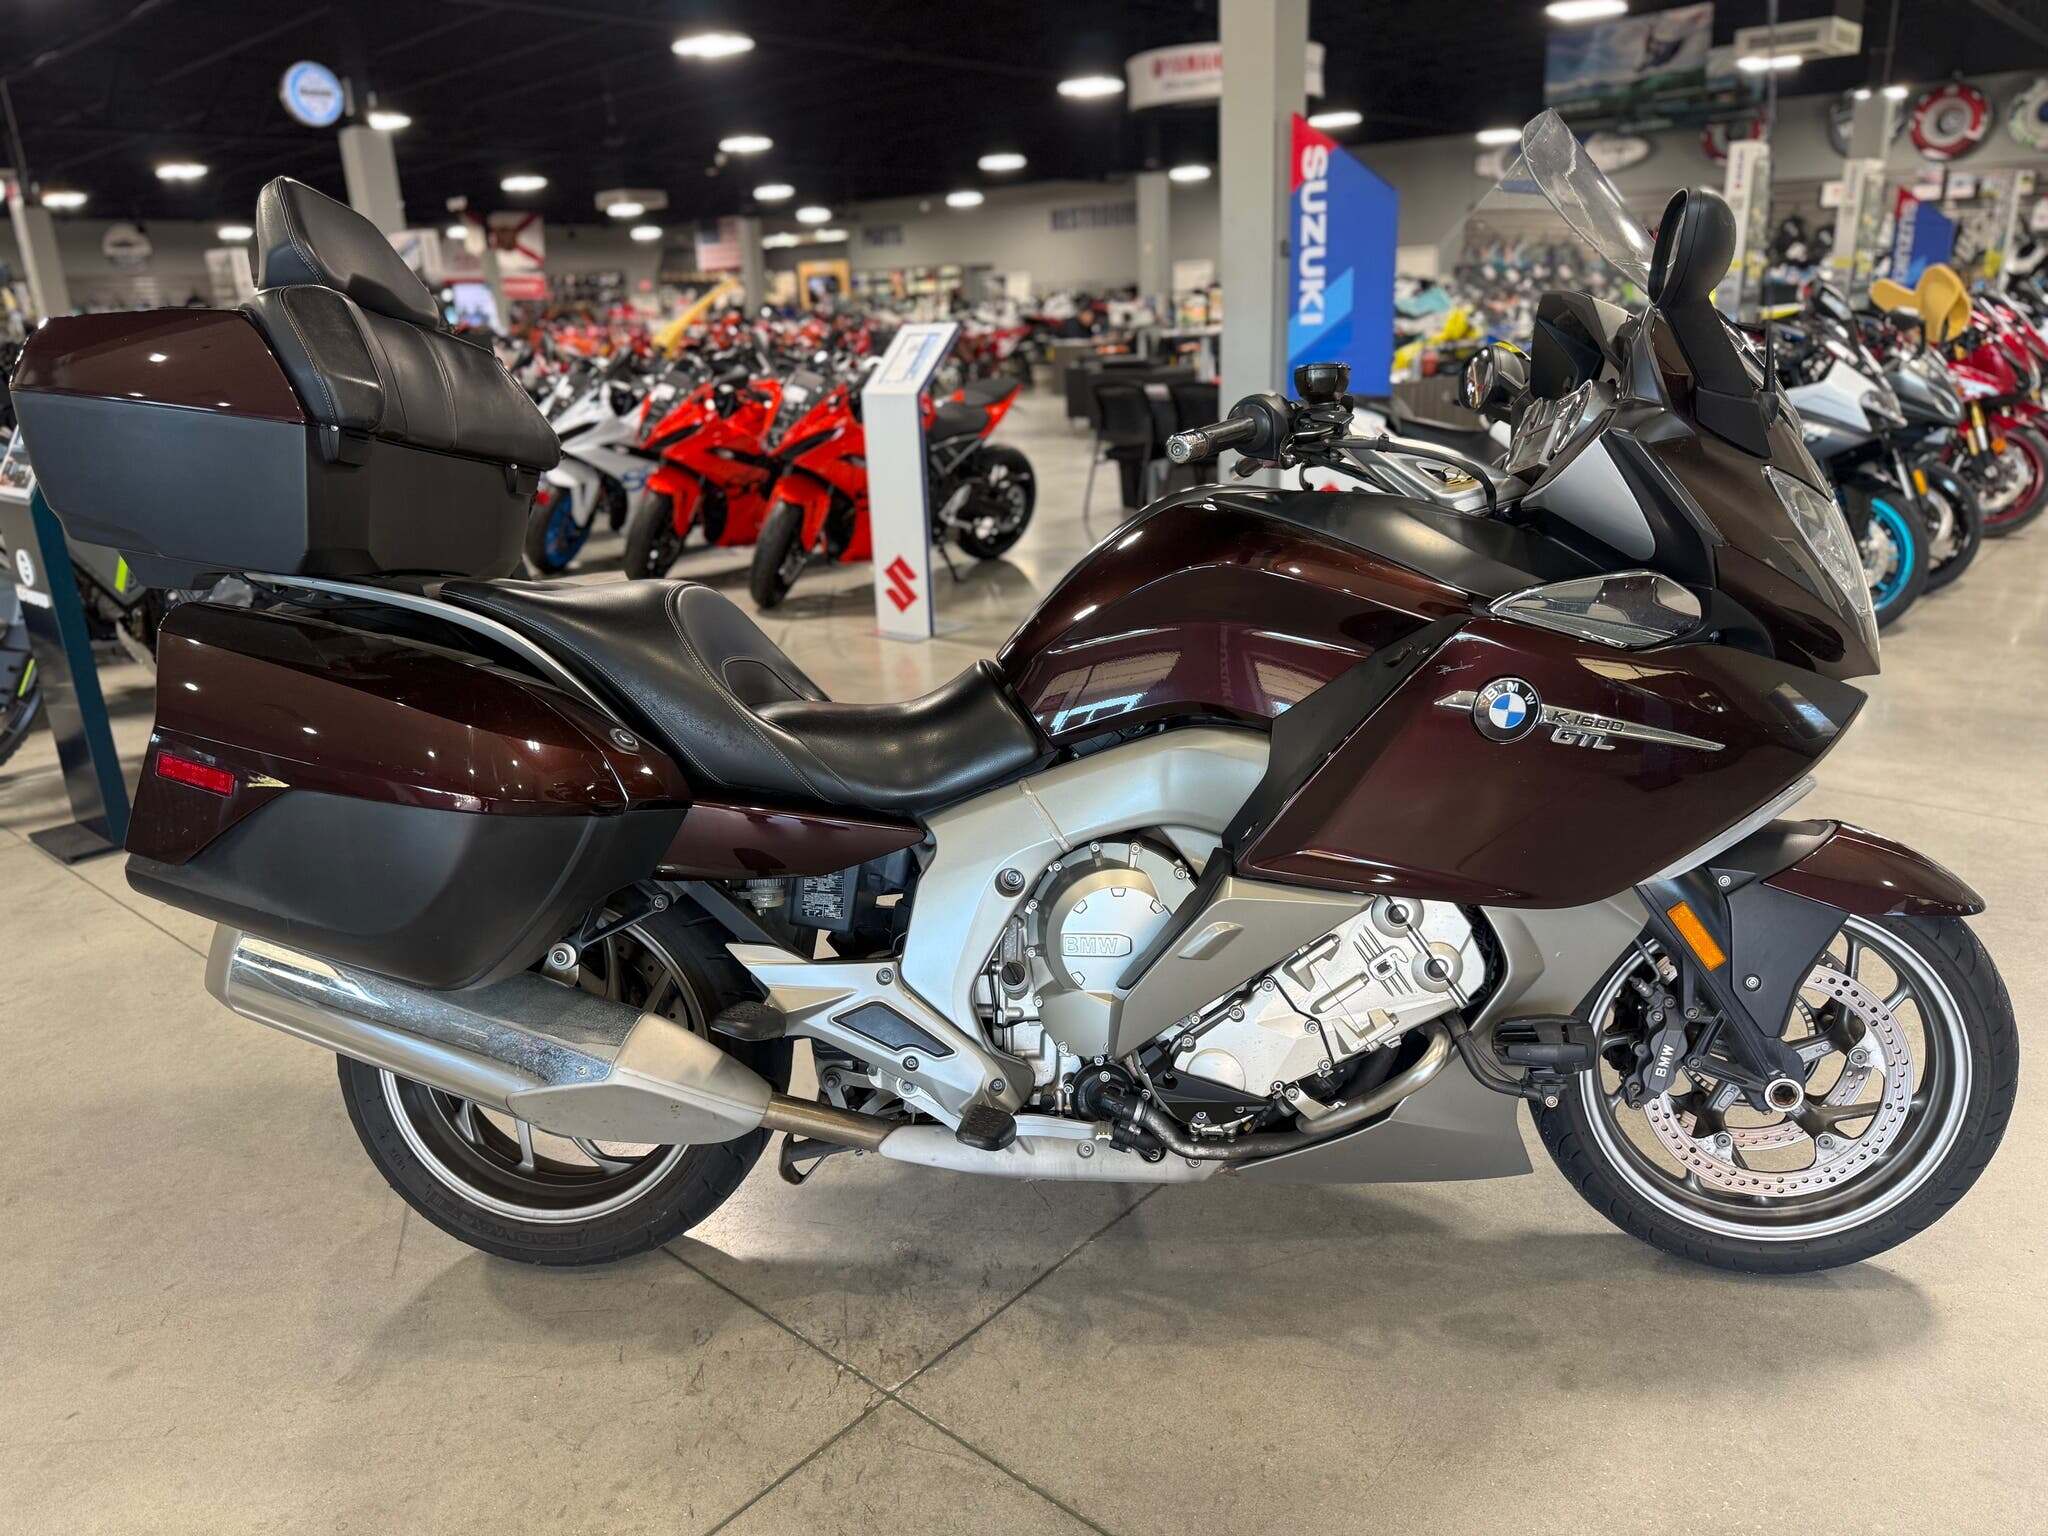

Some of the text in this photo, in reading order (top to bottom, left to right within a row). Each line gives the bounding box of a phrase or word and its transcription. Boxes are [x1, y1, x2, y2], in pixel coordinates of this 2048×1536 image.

[1299, 144, 1328, 326] SUZUKI
[1484, 681, 1536, 705] BMW
[1549, 727, 1616, 751] GTL
[1064, 936, 1118, 955] BMW
[1654, 1044, 1675, 1078] BMW
